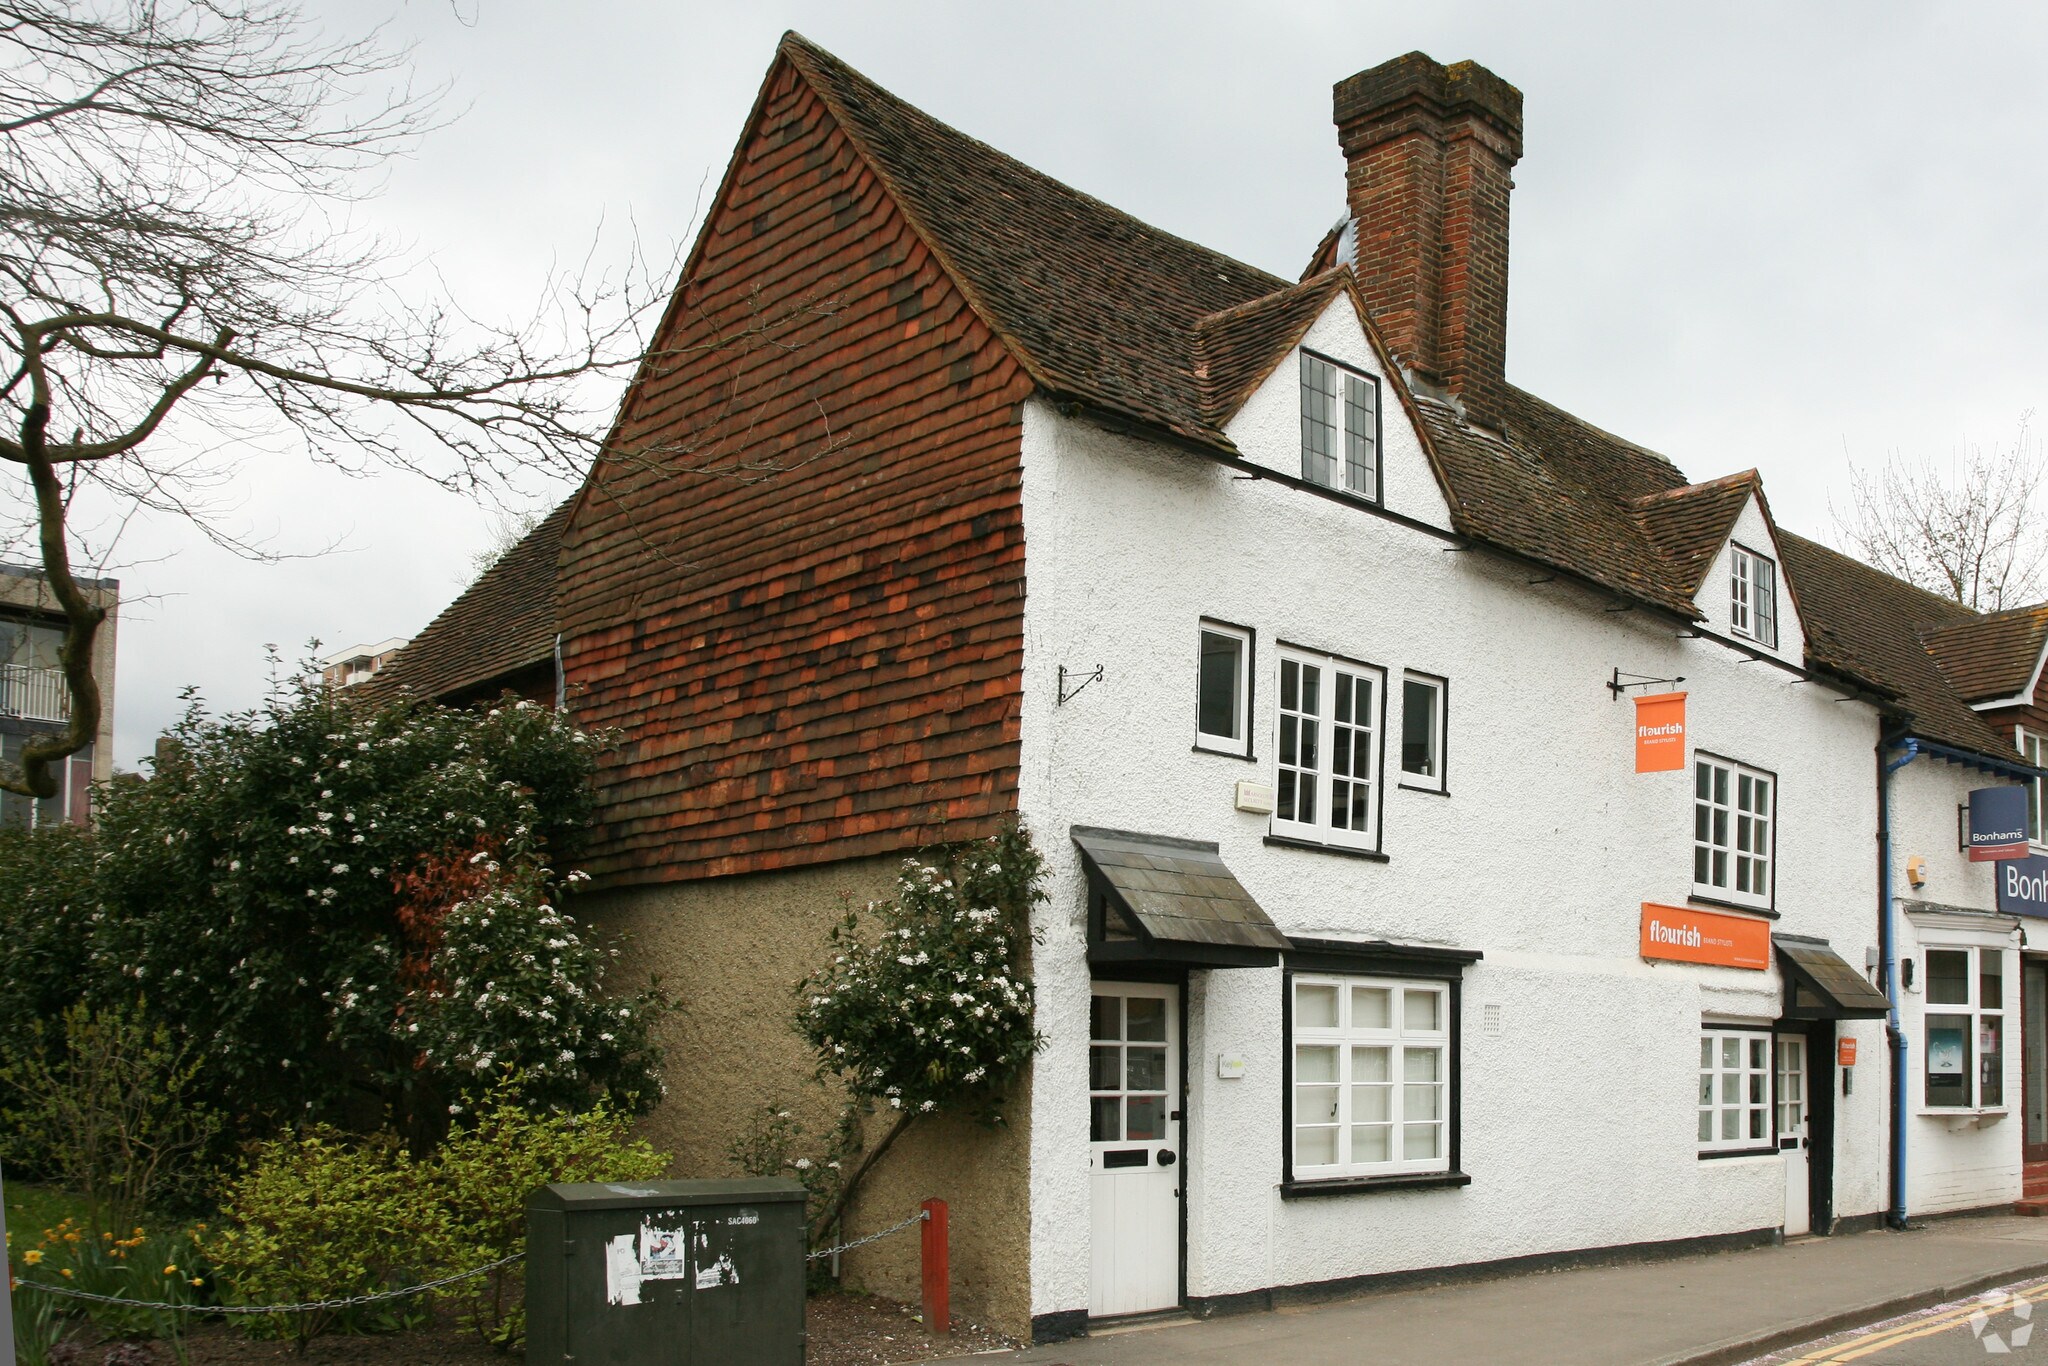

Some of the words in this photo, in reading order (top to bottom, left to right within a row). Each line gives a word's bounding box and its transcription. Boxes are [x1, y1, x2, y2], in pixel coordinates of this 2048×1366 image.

[1638, 722, 1683, 737] flourish
[1973, 830, 2023, 842] Bonhams
[1650, 920, 1701, 948] flourish
